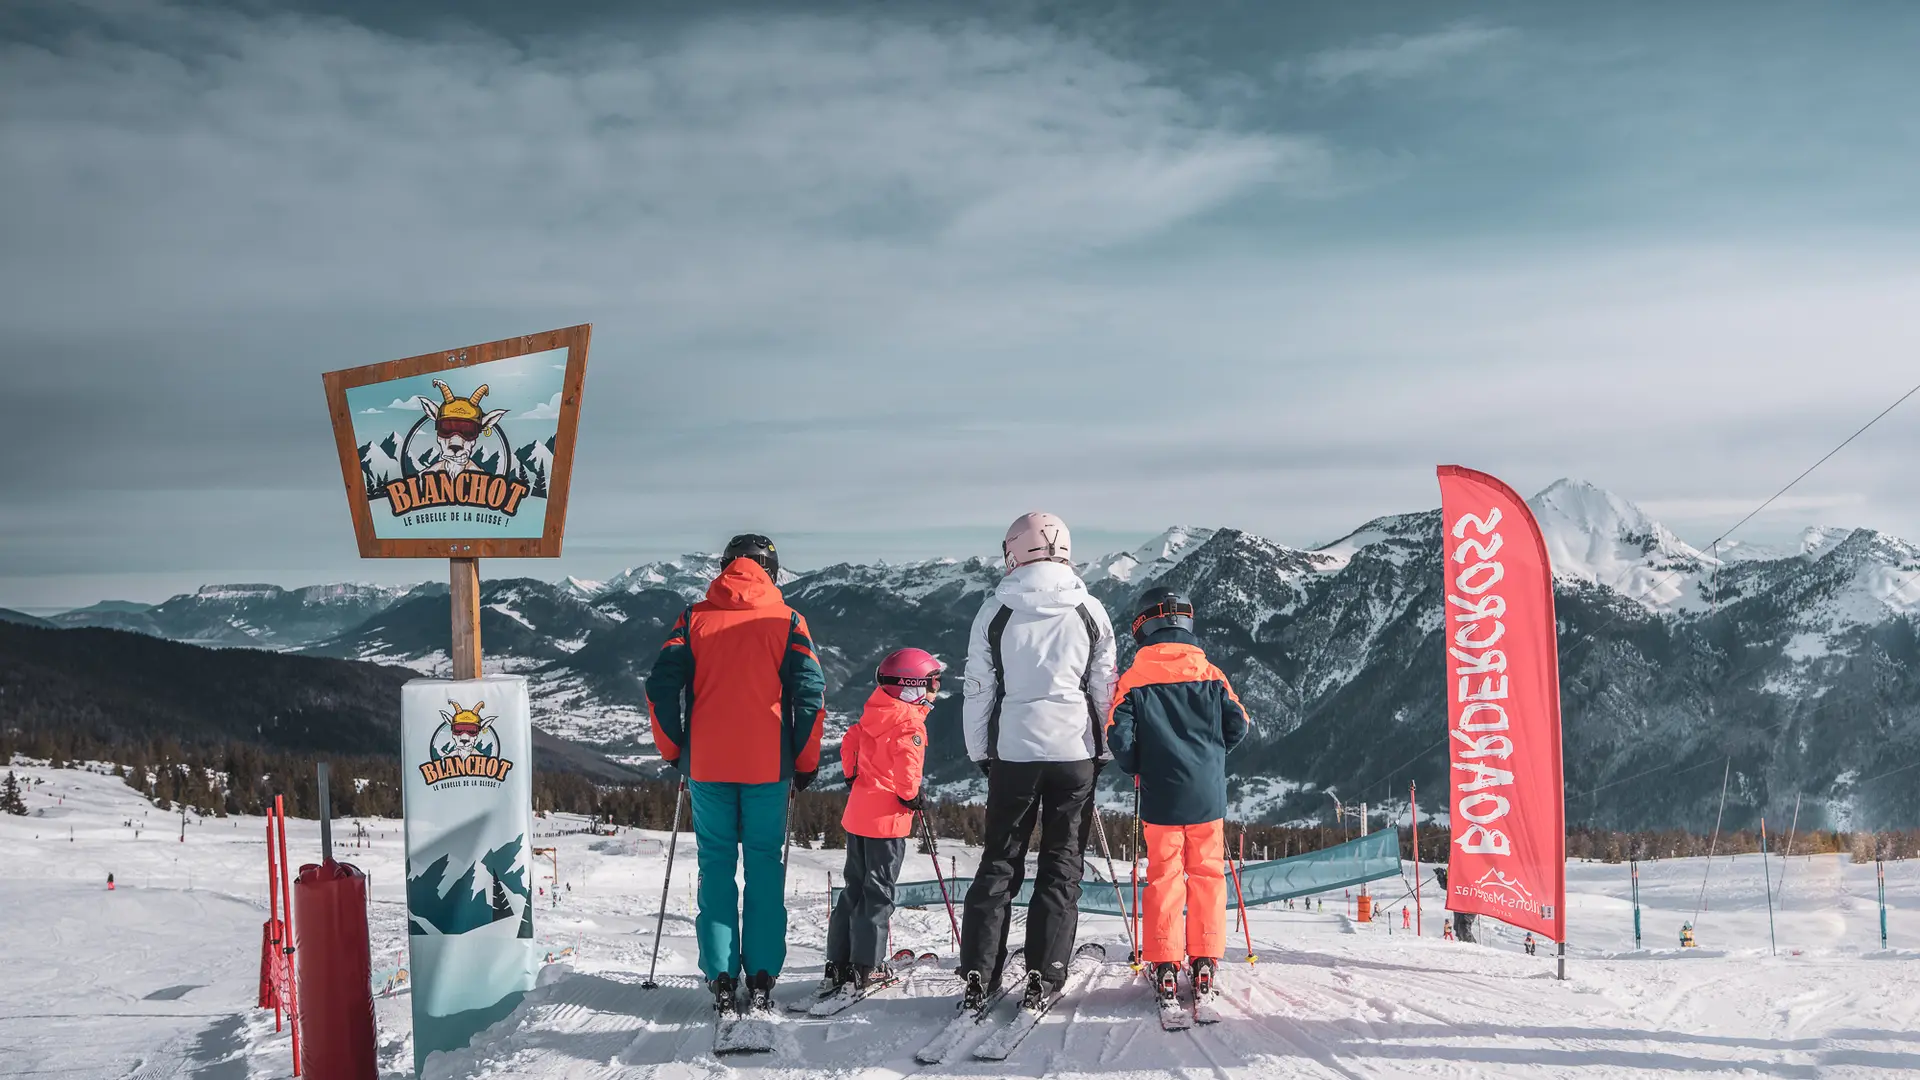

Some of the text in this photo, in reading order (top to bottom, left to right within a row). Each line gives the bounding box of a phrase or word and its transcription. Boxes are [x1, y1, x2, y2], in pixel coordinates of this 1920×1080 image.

[386, 472, 527, 513] BLANCHOT
[403, 517, 413, 527] LE
[416, 512, 447, 524] REBELLE
[450, 511, 460, 521] DE
[463, 512, 472, 522] LA
[476, 513, 502, 526] GLISSE
[420, 755, 512, 784] BLANCHOT
